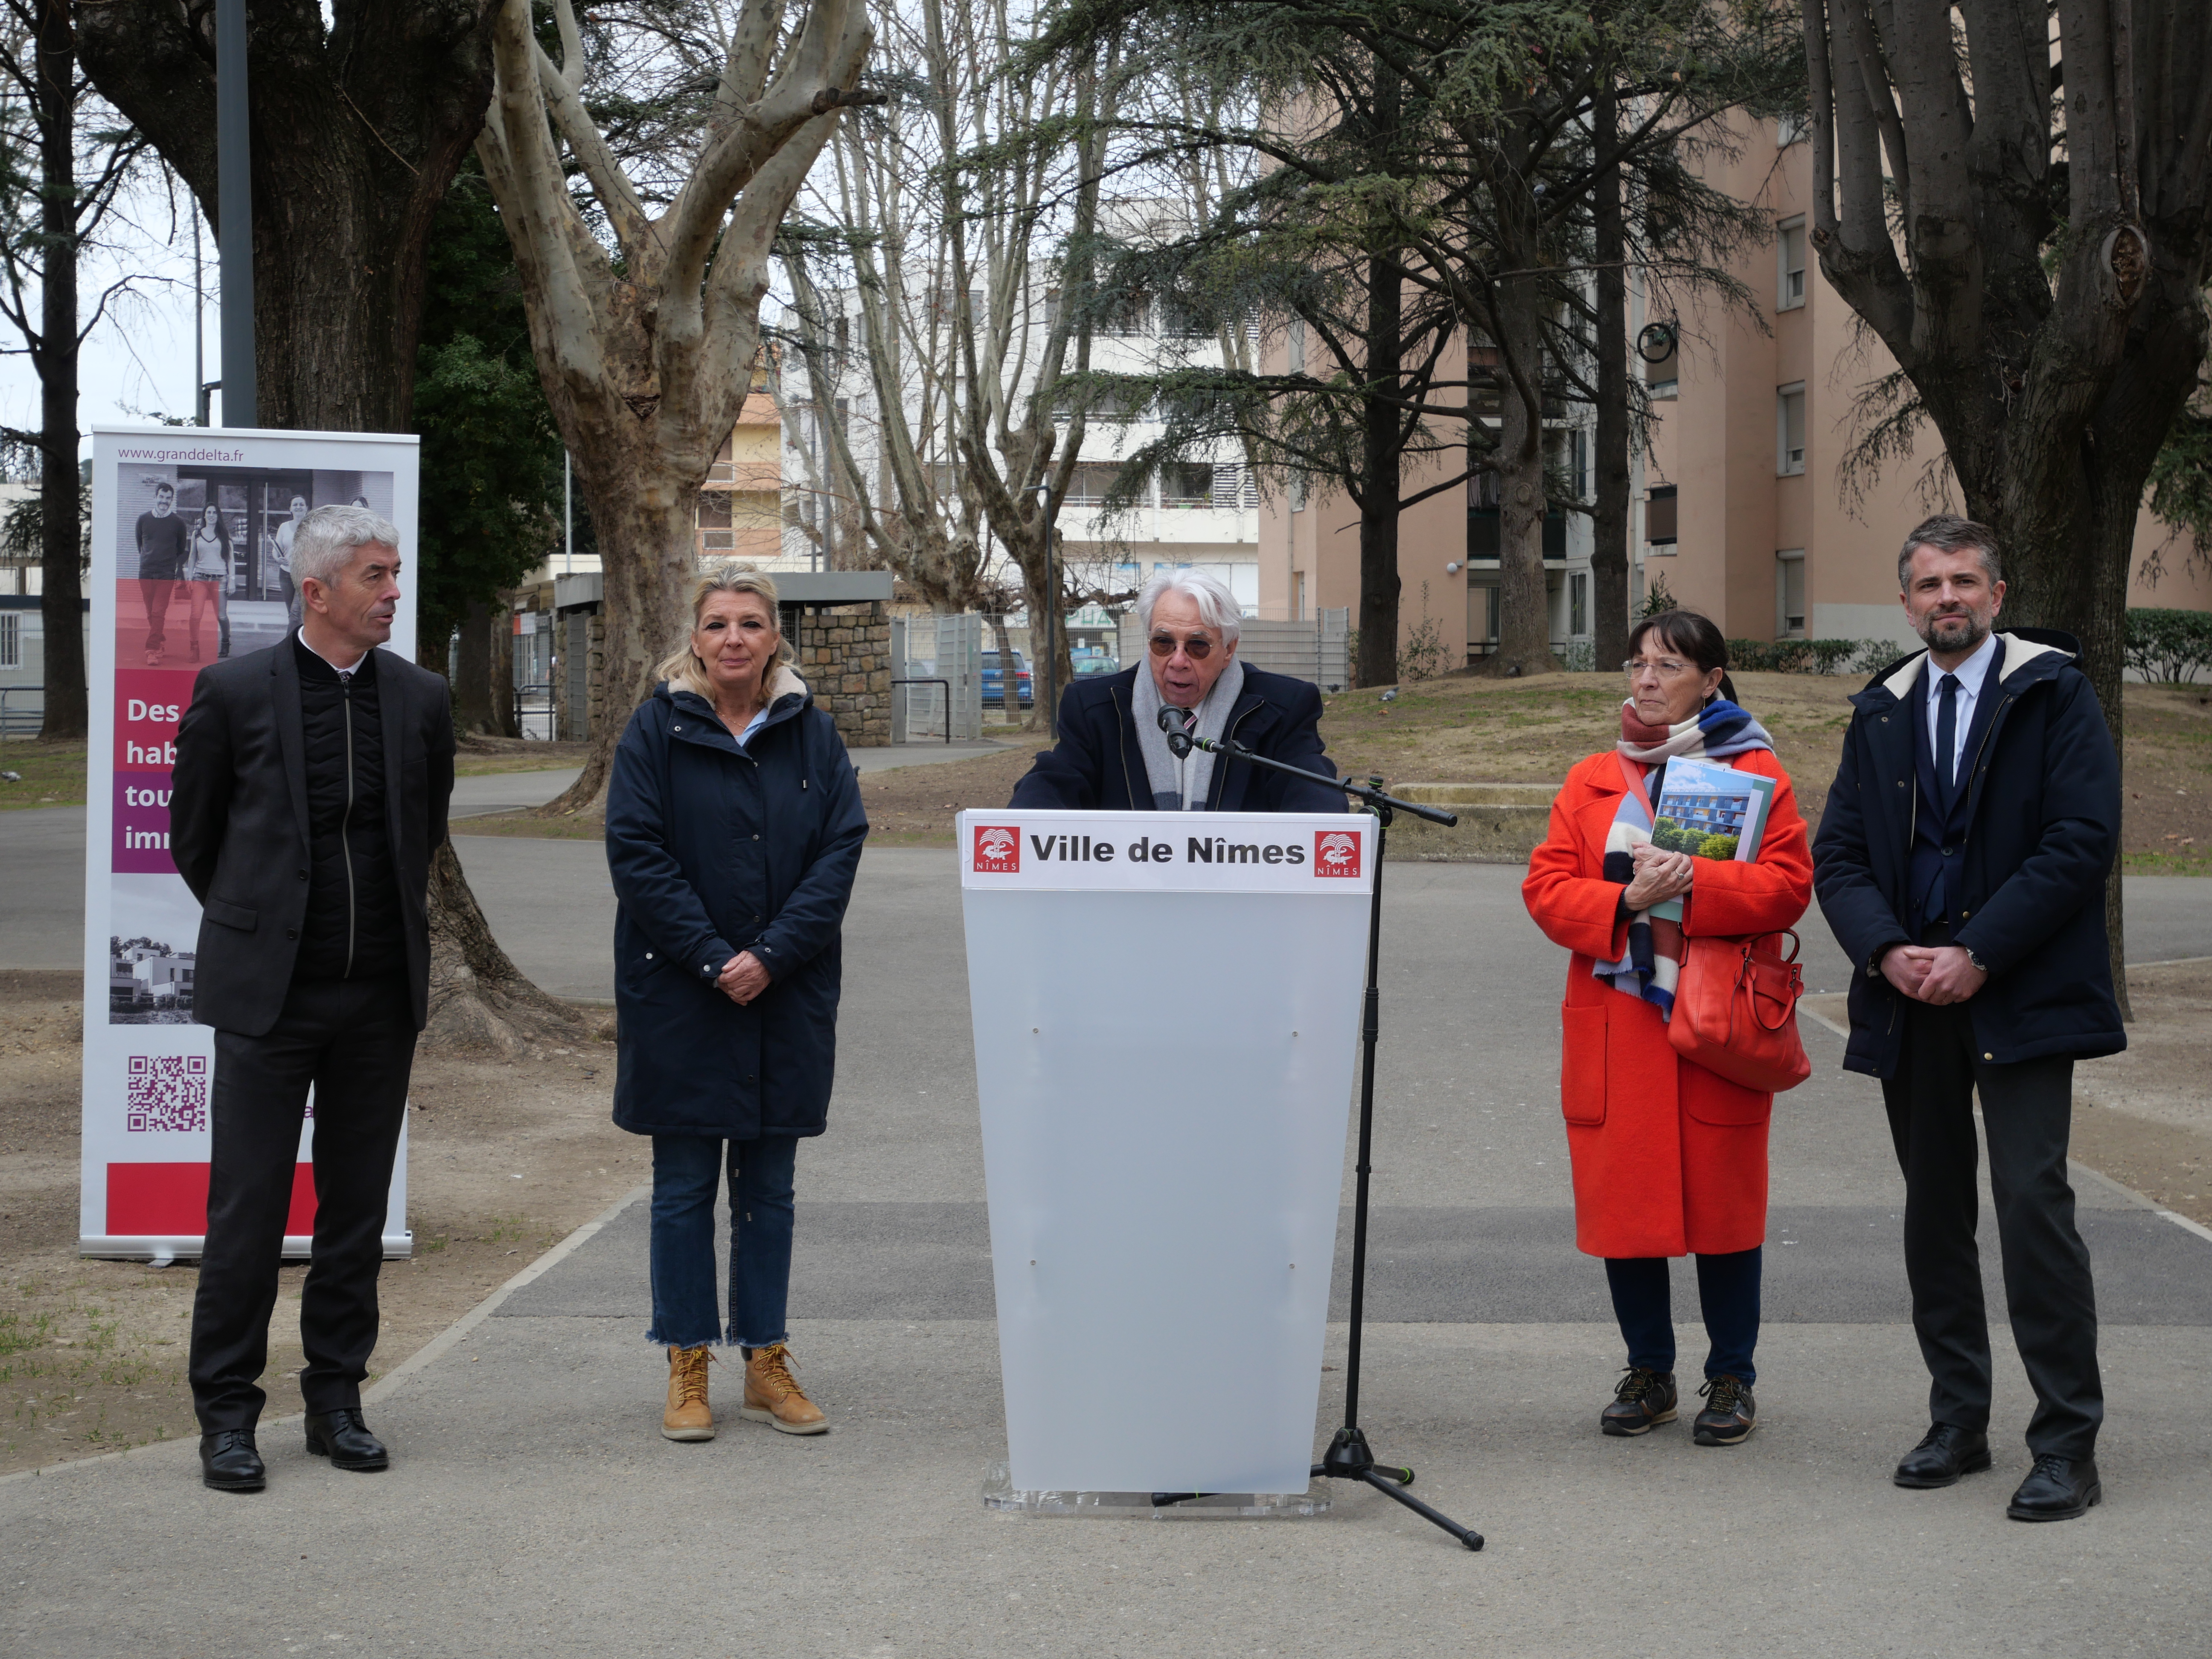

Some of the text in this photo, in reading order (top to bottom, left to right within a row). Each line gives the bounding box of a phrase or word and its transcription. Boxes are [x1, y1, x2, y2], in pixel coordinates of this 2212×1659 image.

[118, 448, 244, 462] www.granddelta.fr
[128, 699, 179, 722] Des
[1030, 835, 1305, 864] Ville de Nîmes
[977, 860, 1016, 870] NÎMES
[1318, 865, 1357, 875] NÎMES
